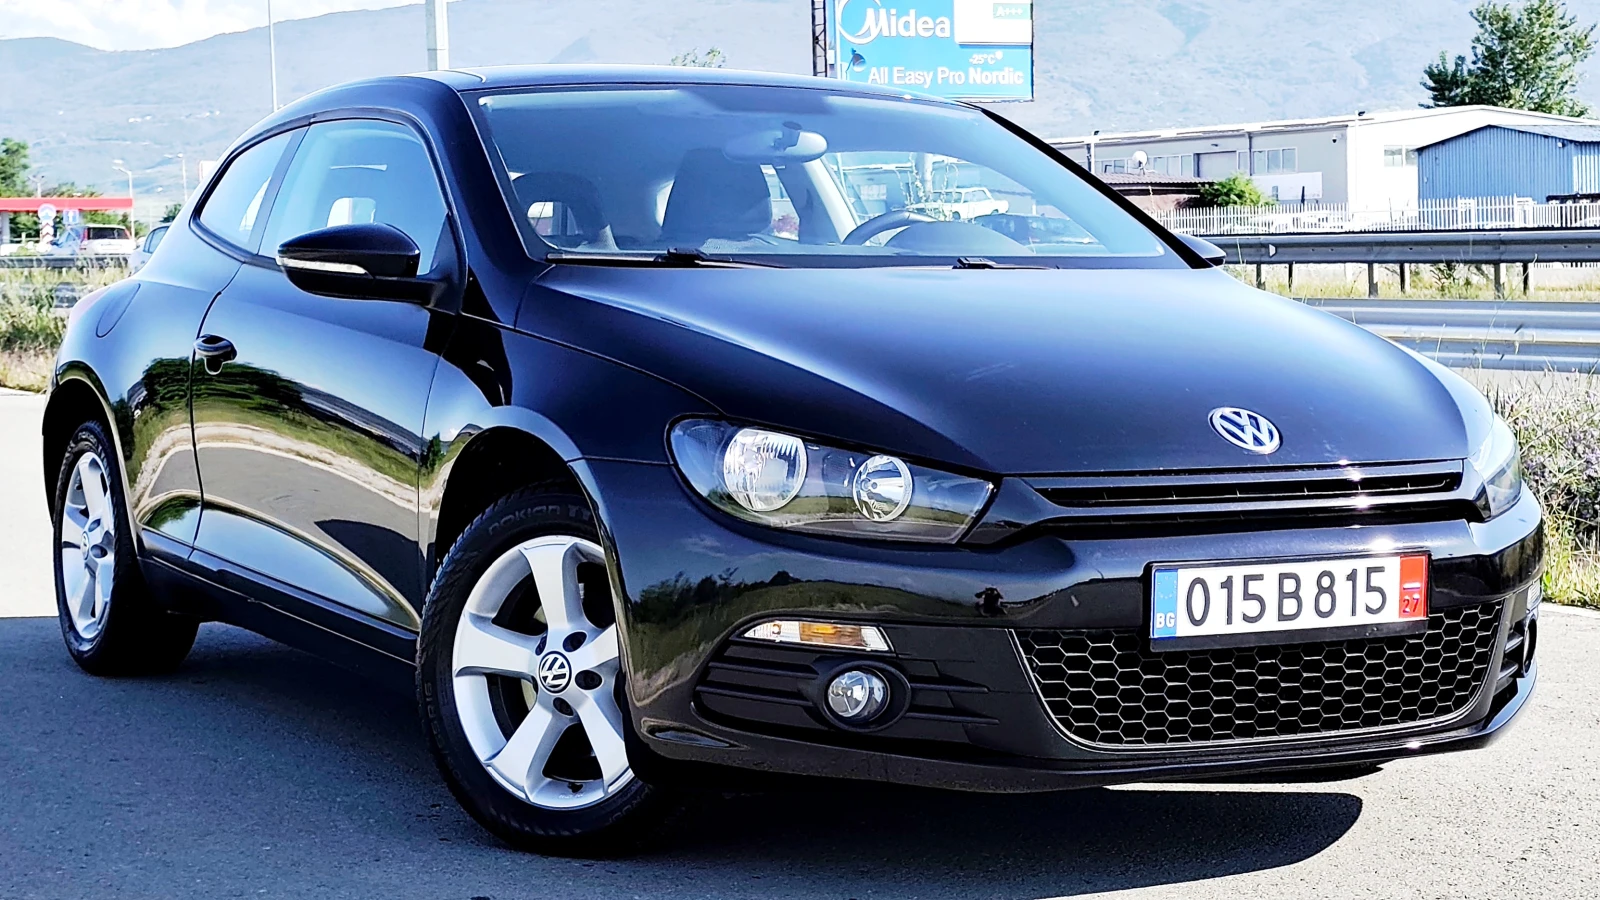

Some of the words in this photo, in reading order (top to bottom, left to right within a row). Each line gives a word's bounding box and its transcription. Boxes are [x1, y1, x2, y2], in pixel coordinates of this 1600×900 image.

[854, 8, 951, 38] Midea
[867, 67, 888, 85] All
[893, 67, 933, 89] Easy
[937, 67, 966, 85] Pro
[968, 67, 1025, 85] Nordic
[1402, 594, 1421, 613] 27
[1155, 611, 1176, 629] BG
